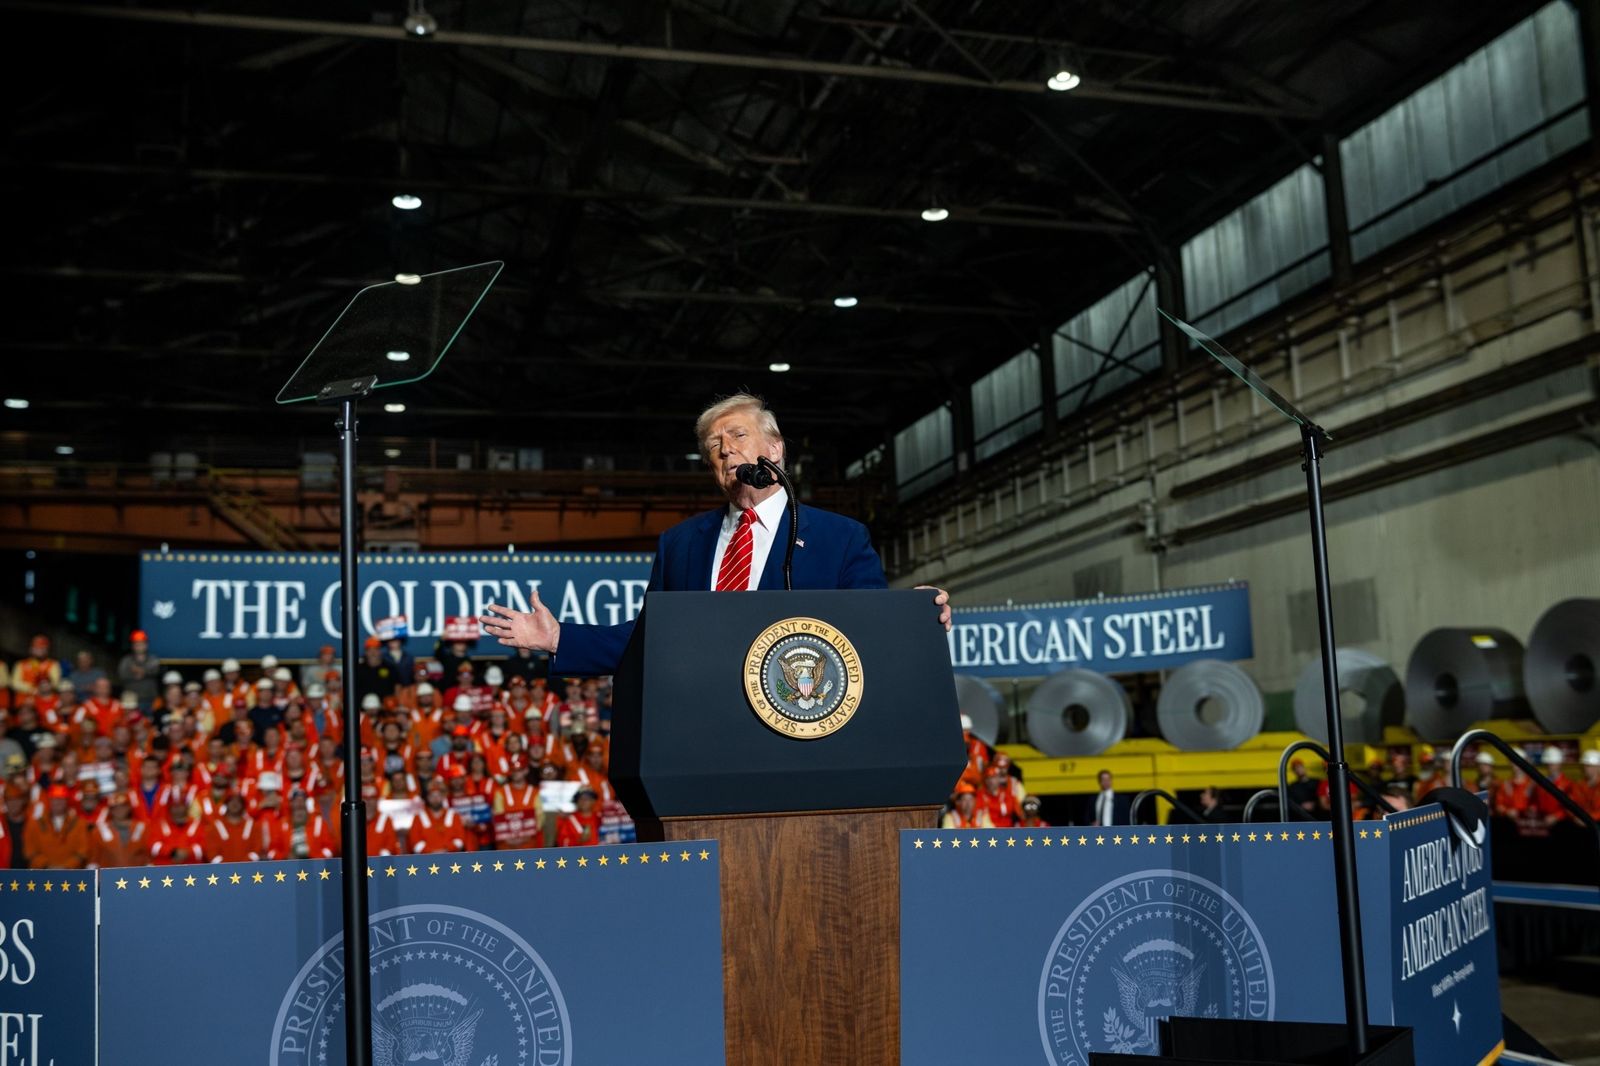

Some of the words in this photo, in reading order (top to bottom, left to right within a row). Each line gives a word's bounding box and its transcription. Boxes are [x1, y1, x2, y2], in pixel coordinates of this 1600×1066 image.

[192, 579, 306, 639] THE
[801, 623, 812, 631] OF
[748, 622, 798, 676] PRESIDENT
[814, 625, 829, 637] THE
[947, 617, 1094, 667] ERICAN
[1104, 605, 1224, 659] STEEL
[832, 635, 859, 683] UNITED
[750, 680, 761, 697] THE
[756, 699, 766, 710] OF
[767, 707, 798, 733] SEAL
[818, 694, 856, 732] STATES
[1163, 882, 1185, 898] OF
[1190, 887, 1221, 914] THE
[1048, 879, 1155, 999] PRESIDENT
[1401, 900, 1462, 981] AMERICAN
[1461, 887, 1490, 944] STEEL
[1221, 909, 1268, 1019] UNITED
[282, 915, 416, 1055] PRESINT
[427, 919, 455, 937] OF
[461, 924, 500, 953] THE
[502, 946, 562, 1066] UNITED
[1051, 1008, 1069, 1048] THE
